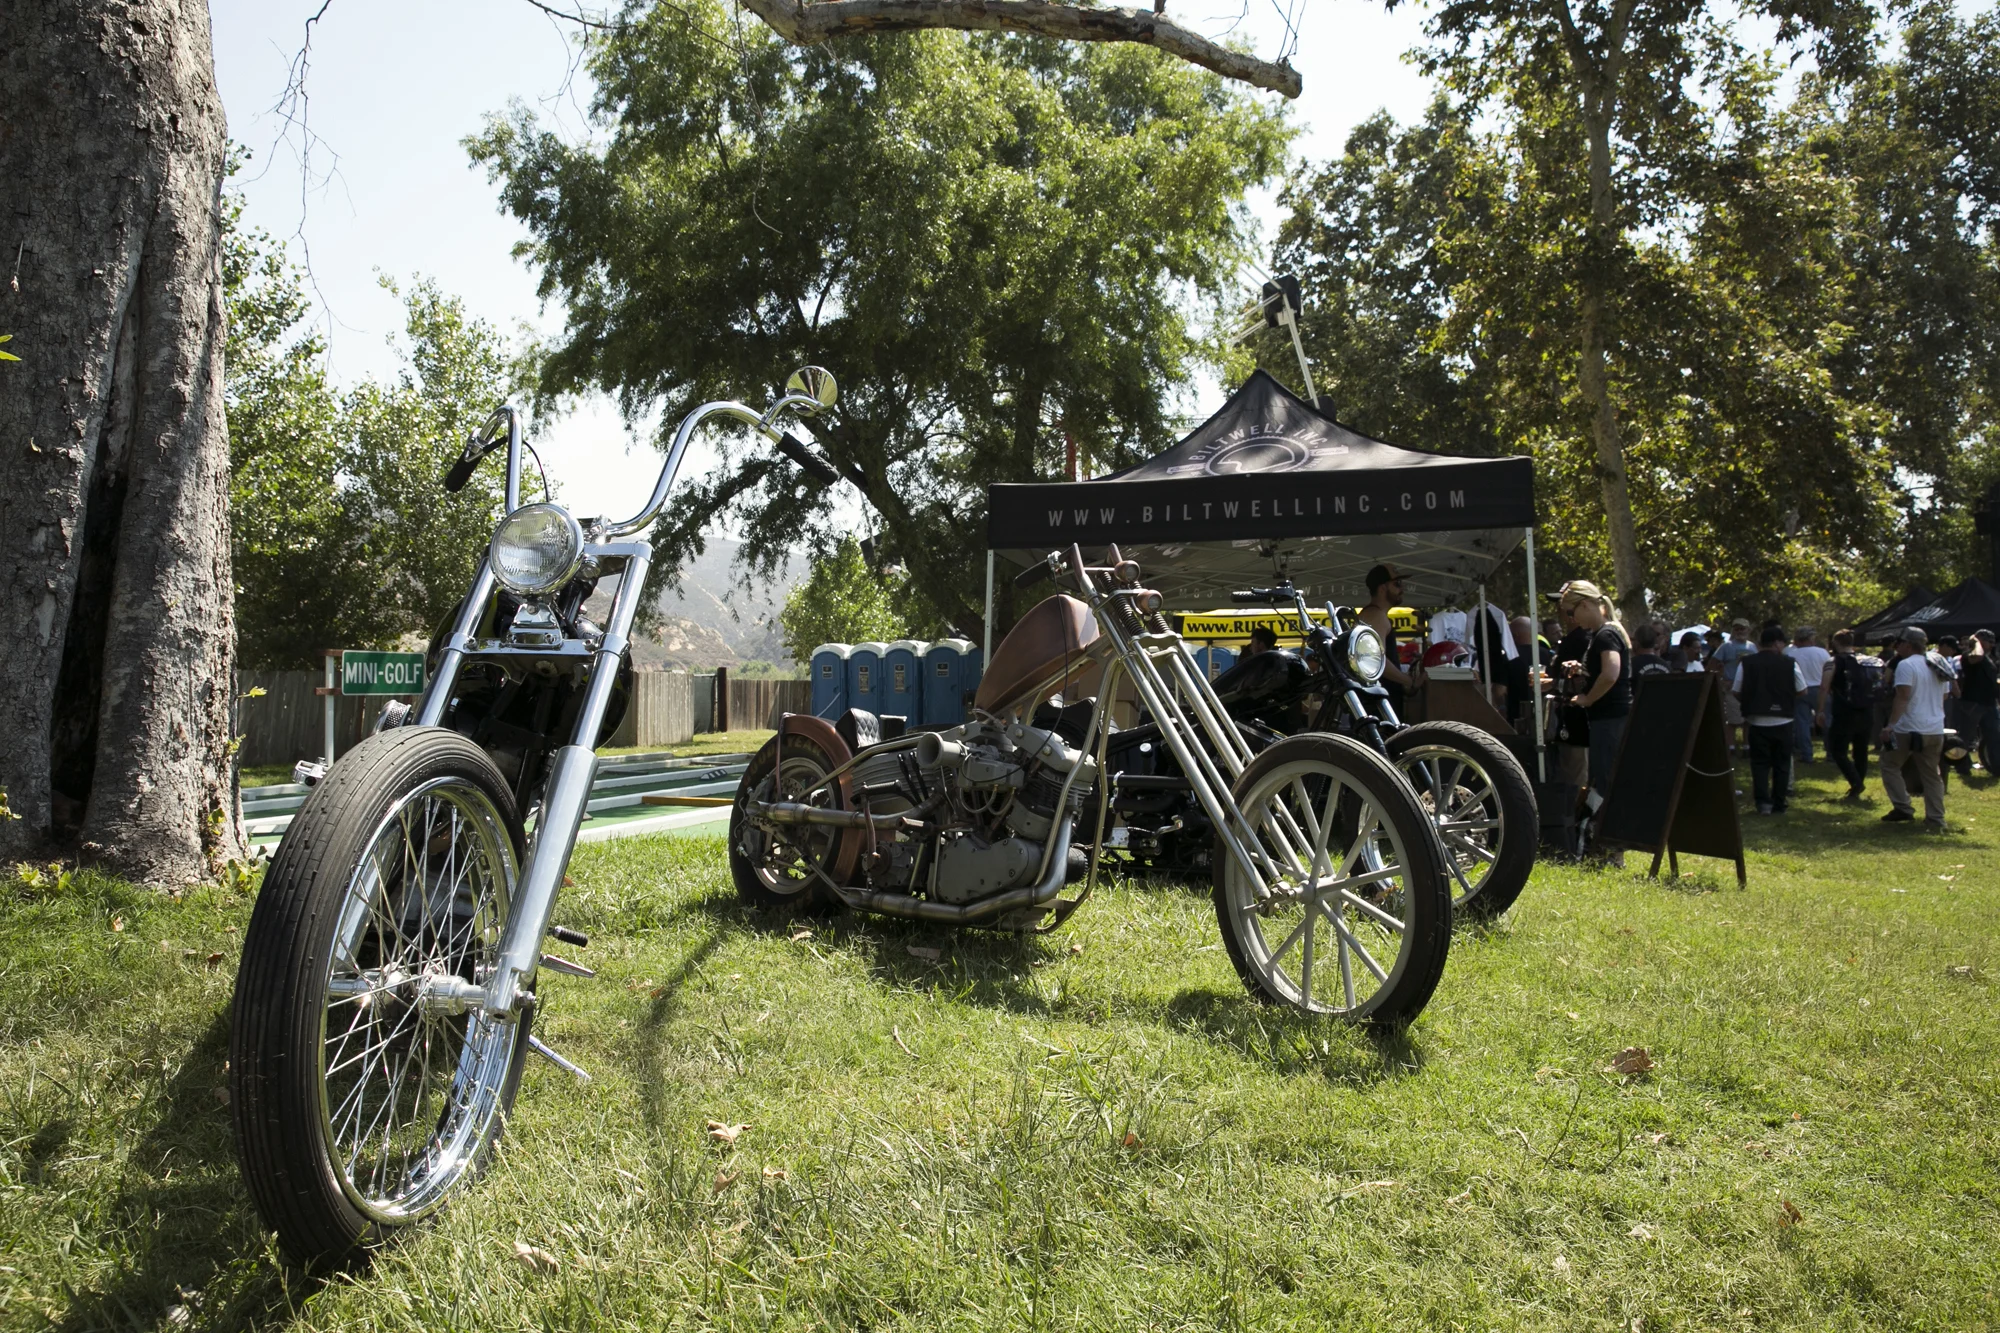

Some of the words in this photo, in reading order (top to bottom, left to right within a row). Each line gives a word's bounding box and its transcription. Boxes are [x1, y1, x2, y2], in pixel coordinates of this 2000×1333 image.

[1188, 423, 1285, 461] BILTWELL
[1048, 489, 1465, 527] WWW.BILTWELLINC.COM
[345, 662, 422, 685] MINI-GOLF
